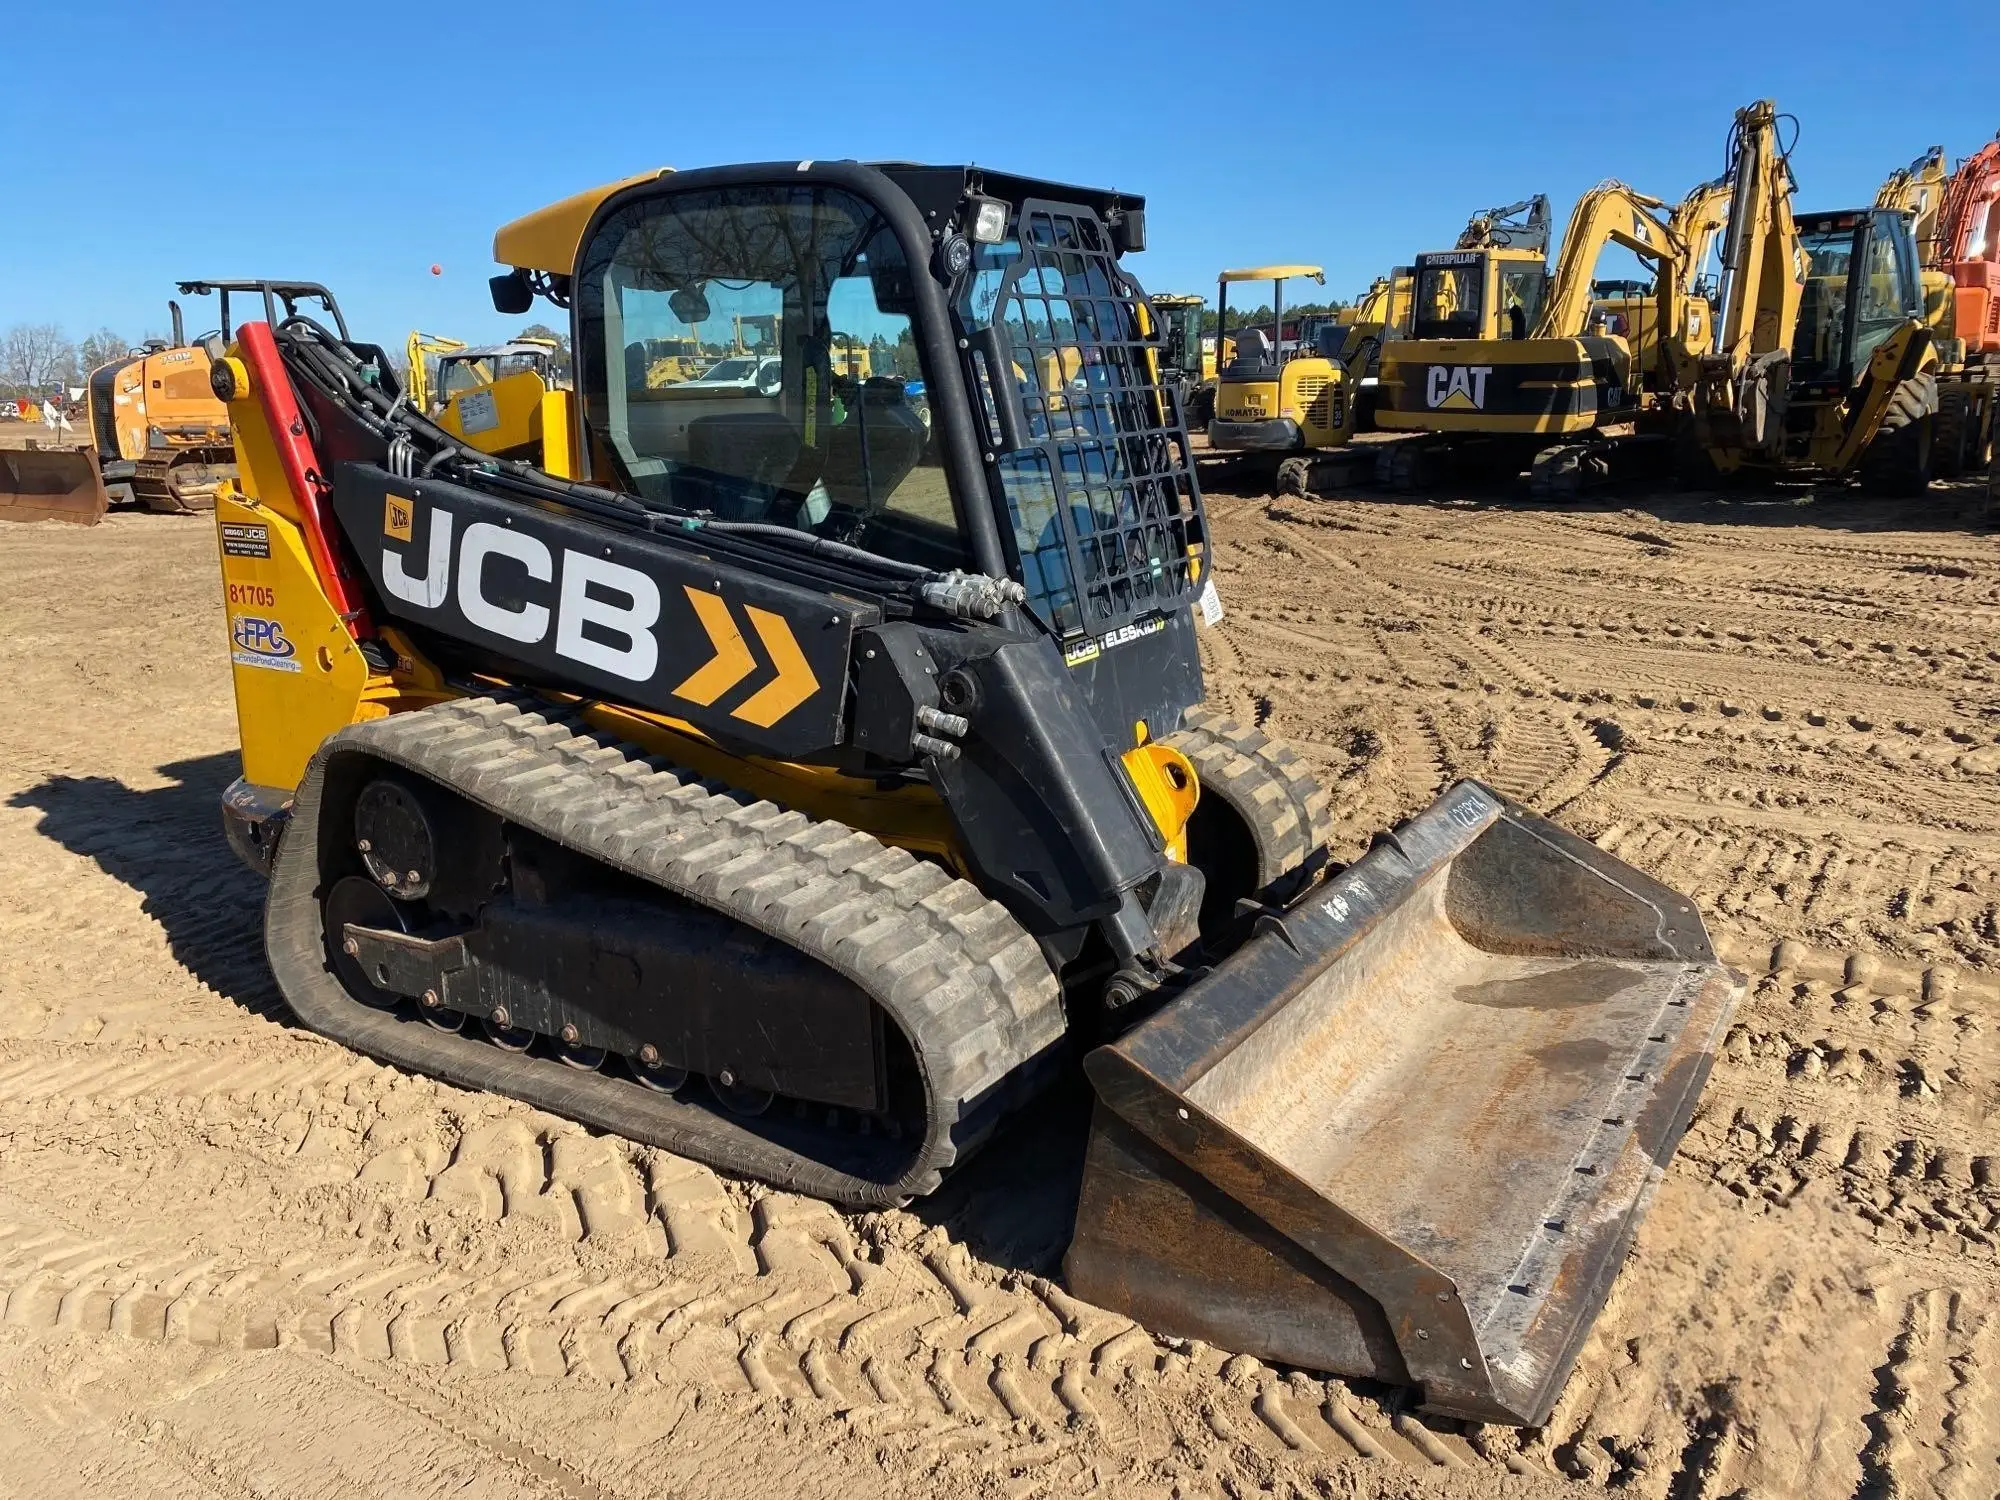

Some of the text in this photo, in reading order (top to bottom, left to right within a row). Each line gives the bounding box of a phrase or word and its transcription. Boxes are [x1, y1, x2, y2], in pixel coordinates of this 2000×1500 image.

[1426, 254, 1476, 265] CATERPILLAR
[1427, 366, 1493, 410] CAT
[1608, 387, 1622, 407] CAT
[1225, 408, 1267, 417] KOMATSU
[392, 505, 408, 527] JCB
[246, 528, 266, 540] JCB
[230, 584, 275, 607] 81705
[382, 507, 661, 682] JCB
[244, 616, 284, 651] FPC
[1068, 618, 1155, 661] JCB TELESKID
